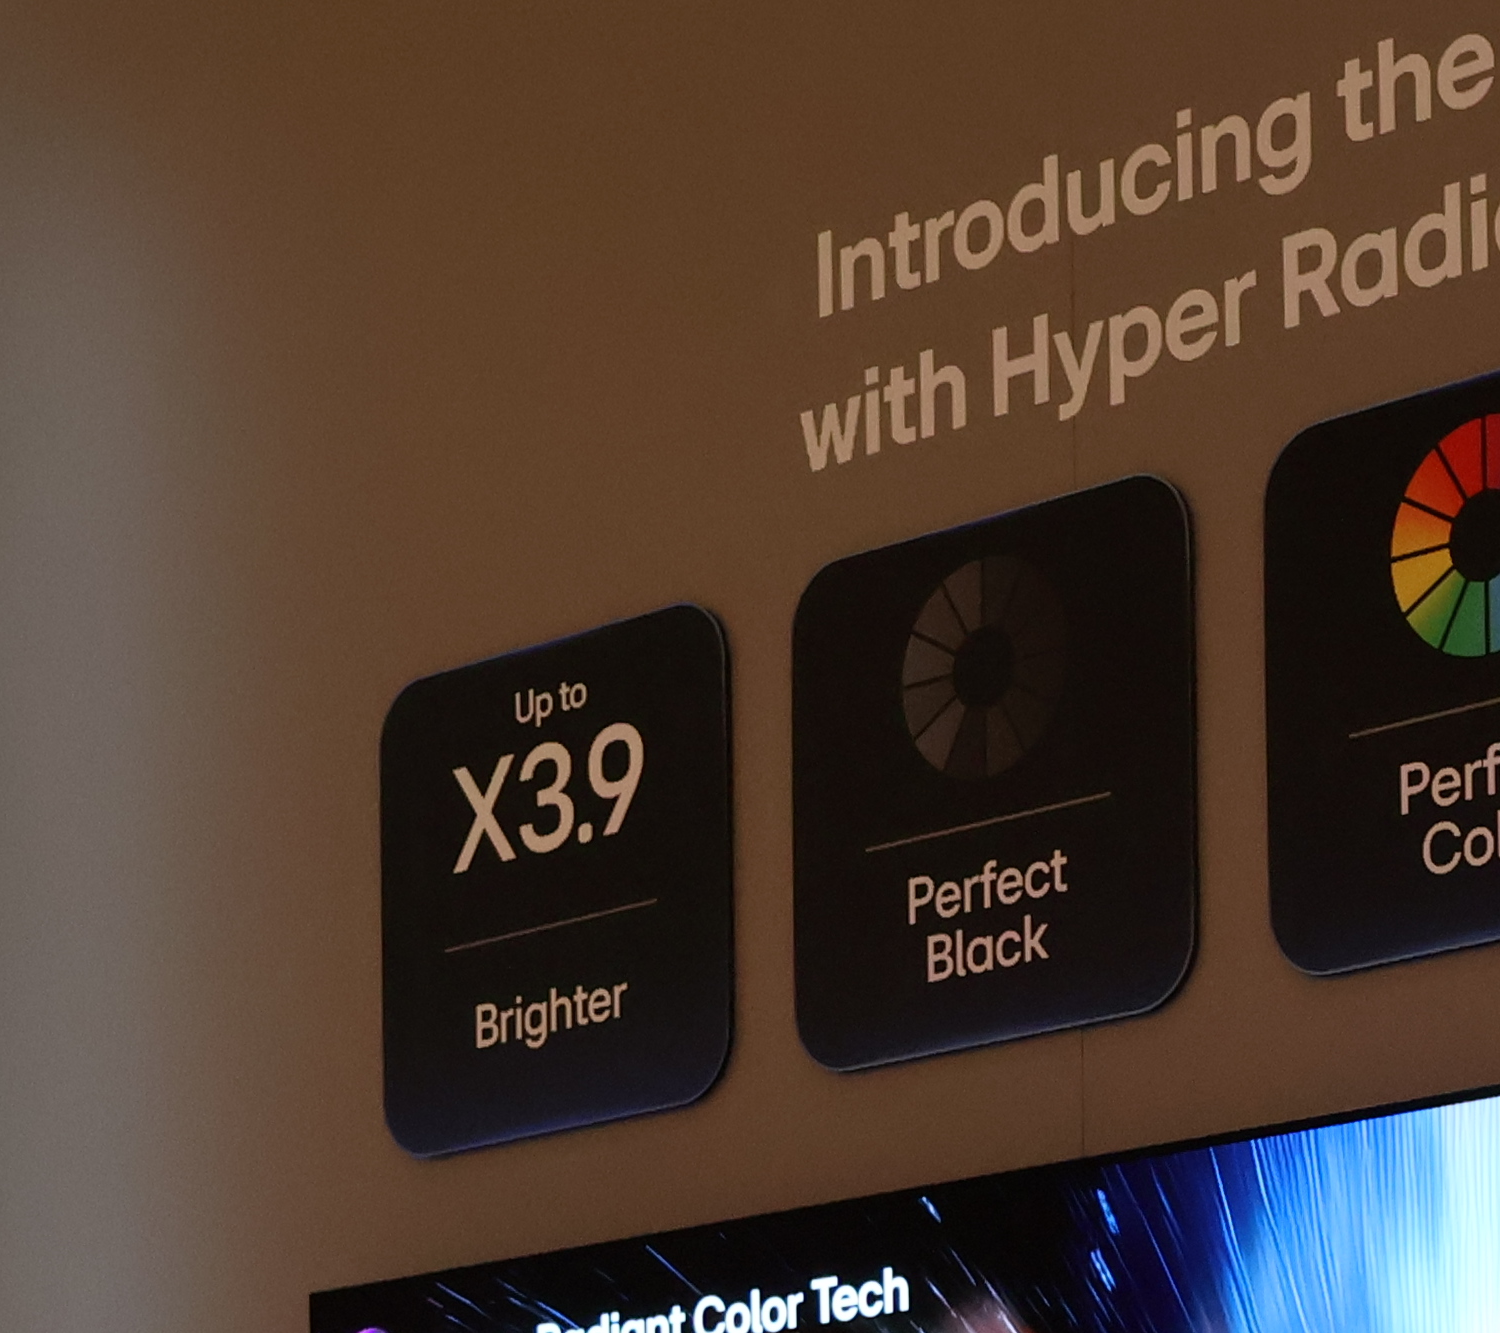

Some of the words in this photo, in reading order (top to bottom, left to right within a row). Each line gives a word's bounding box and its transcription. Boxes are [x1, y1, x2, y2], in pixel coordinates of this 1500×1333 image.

[818, 92, 1311, 318] Introducing
[1337, 34, 1494, 141] the
[800, 348, 967, 473] with
[991, 269, 1257, 422] Hyper
[516, 689, 553, 725] Up
[559, 682, 586, 711] to
[453, 723, 643, 873] X3.9
[909, 850, 1067, 925] Perfect
[928, 915, 1048, 982] Black
[476, 983, 627, 1048] Brighter
[811, 1267, 909, 1324] Tech
